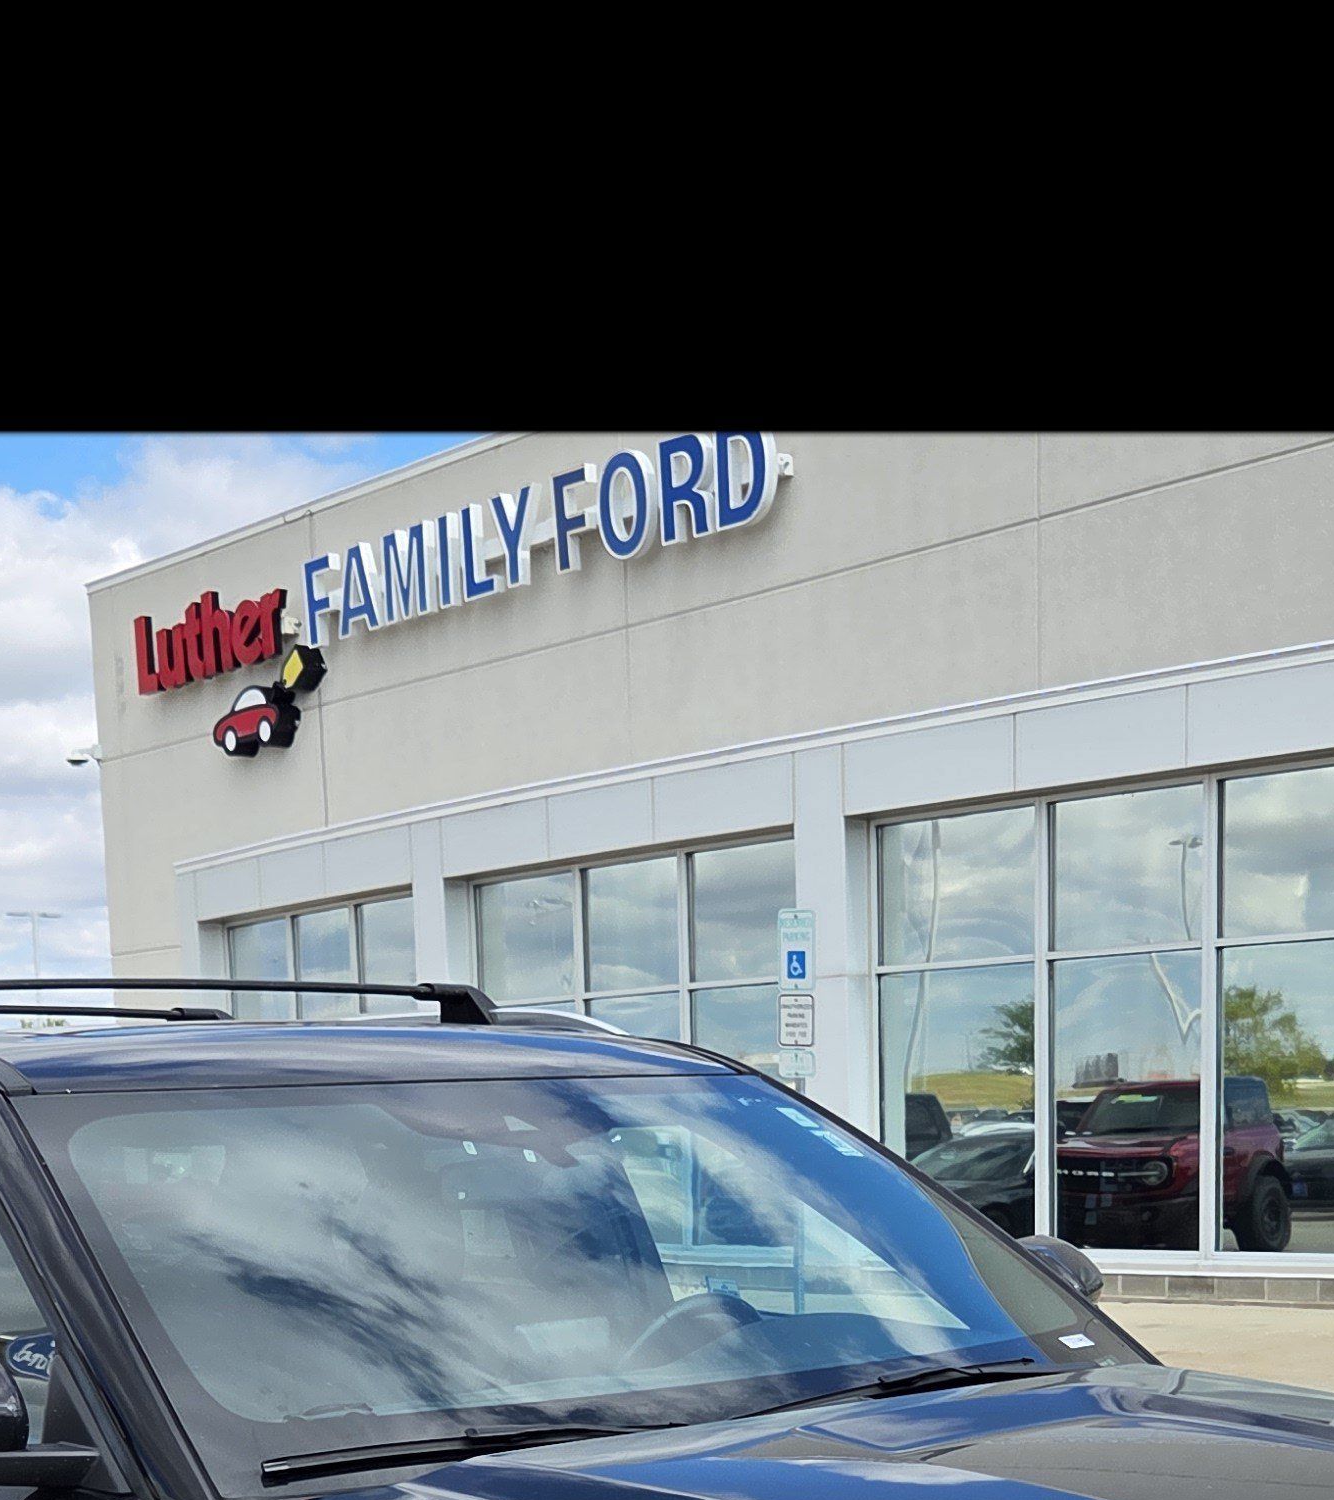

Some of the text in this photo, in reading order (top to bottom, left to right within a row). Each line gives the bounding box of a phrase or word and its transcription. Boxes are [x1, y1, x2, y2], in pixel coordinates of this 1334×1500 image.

[134, 430, 778, 695] Luther FAMILY FORD
